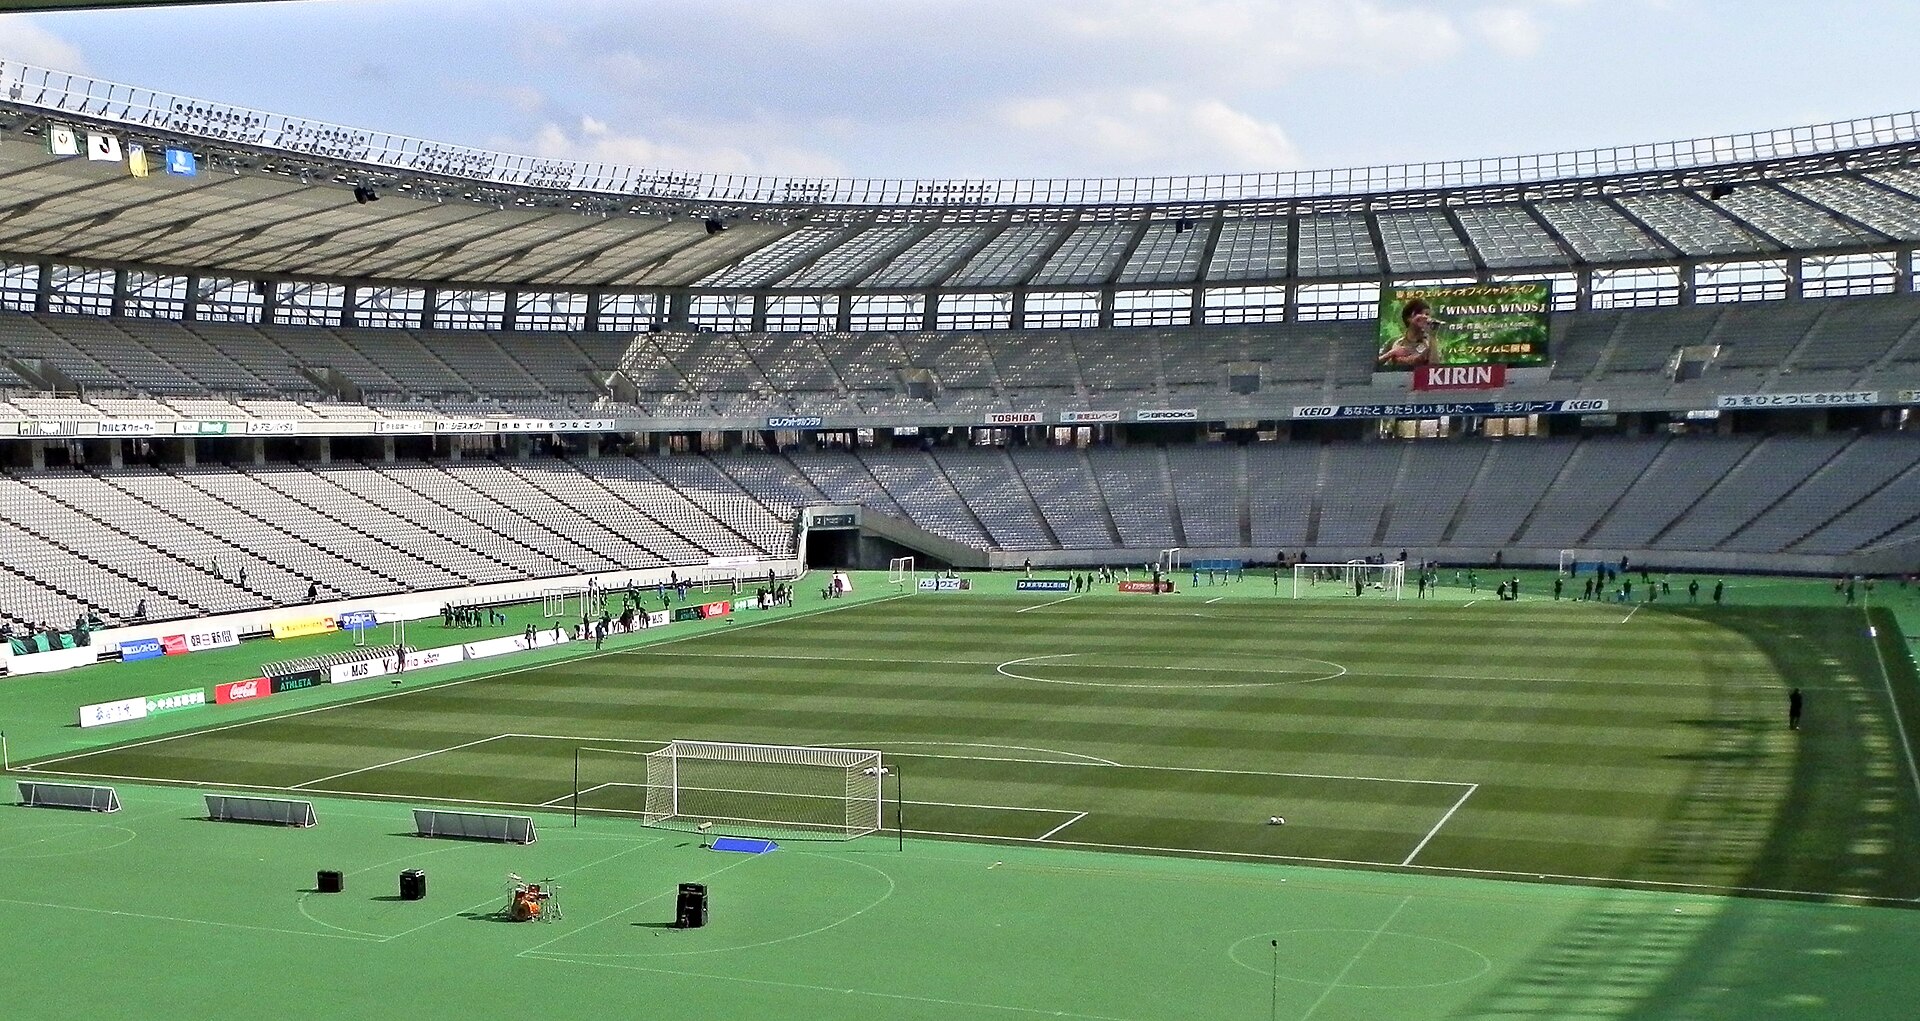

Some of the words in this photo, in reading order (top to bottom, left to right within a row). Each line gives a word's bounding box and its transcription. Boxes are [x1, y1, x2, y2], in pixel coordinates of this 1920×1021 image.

[1428, 366, 1492, 386] KIRIN
[1569, 400, 1603, 411] KEIO
[1724, 392, 1872, 406] 力をひとつに合わせて
[1299, 407, 1332, 416] KEIO
[1343, 406, 1381, 415] あなたと
[1384, 405, 1432, 415] あたらしい
[1435, 403, 1475, 414] あしたへ
[1493, 402, 1555, 412] 京王グループ
[991, 414, 1037, 423] TOSHIBA
[351, 663, 369, 678] MJS
[279, 679, 313, 692] ATHLETA
